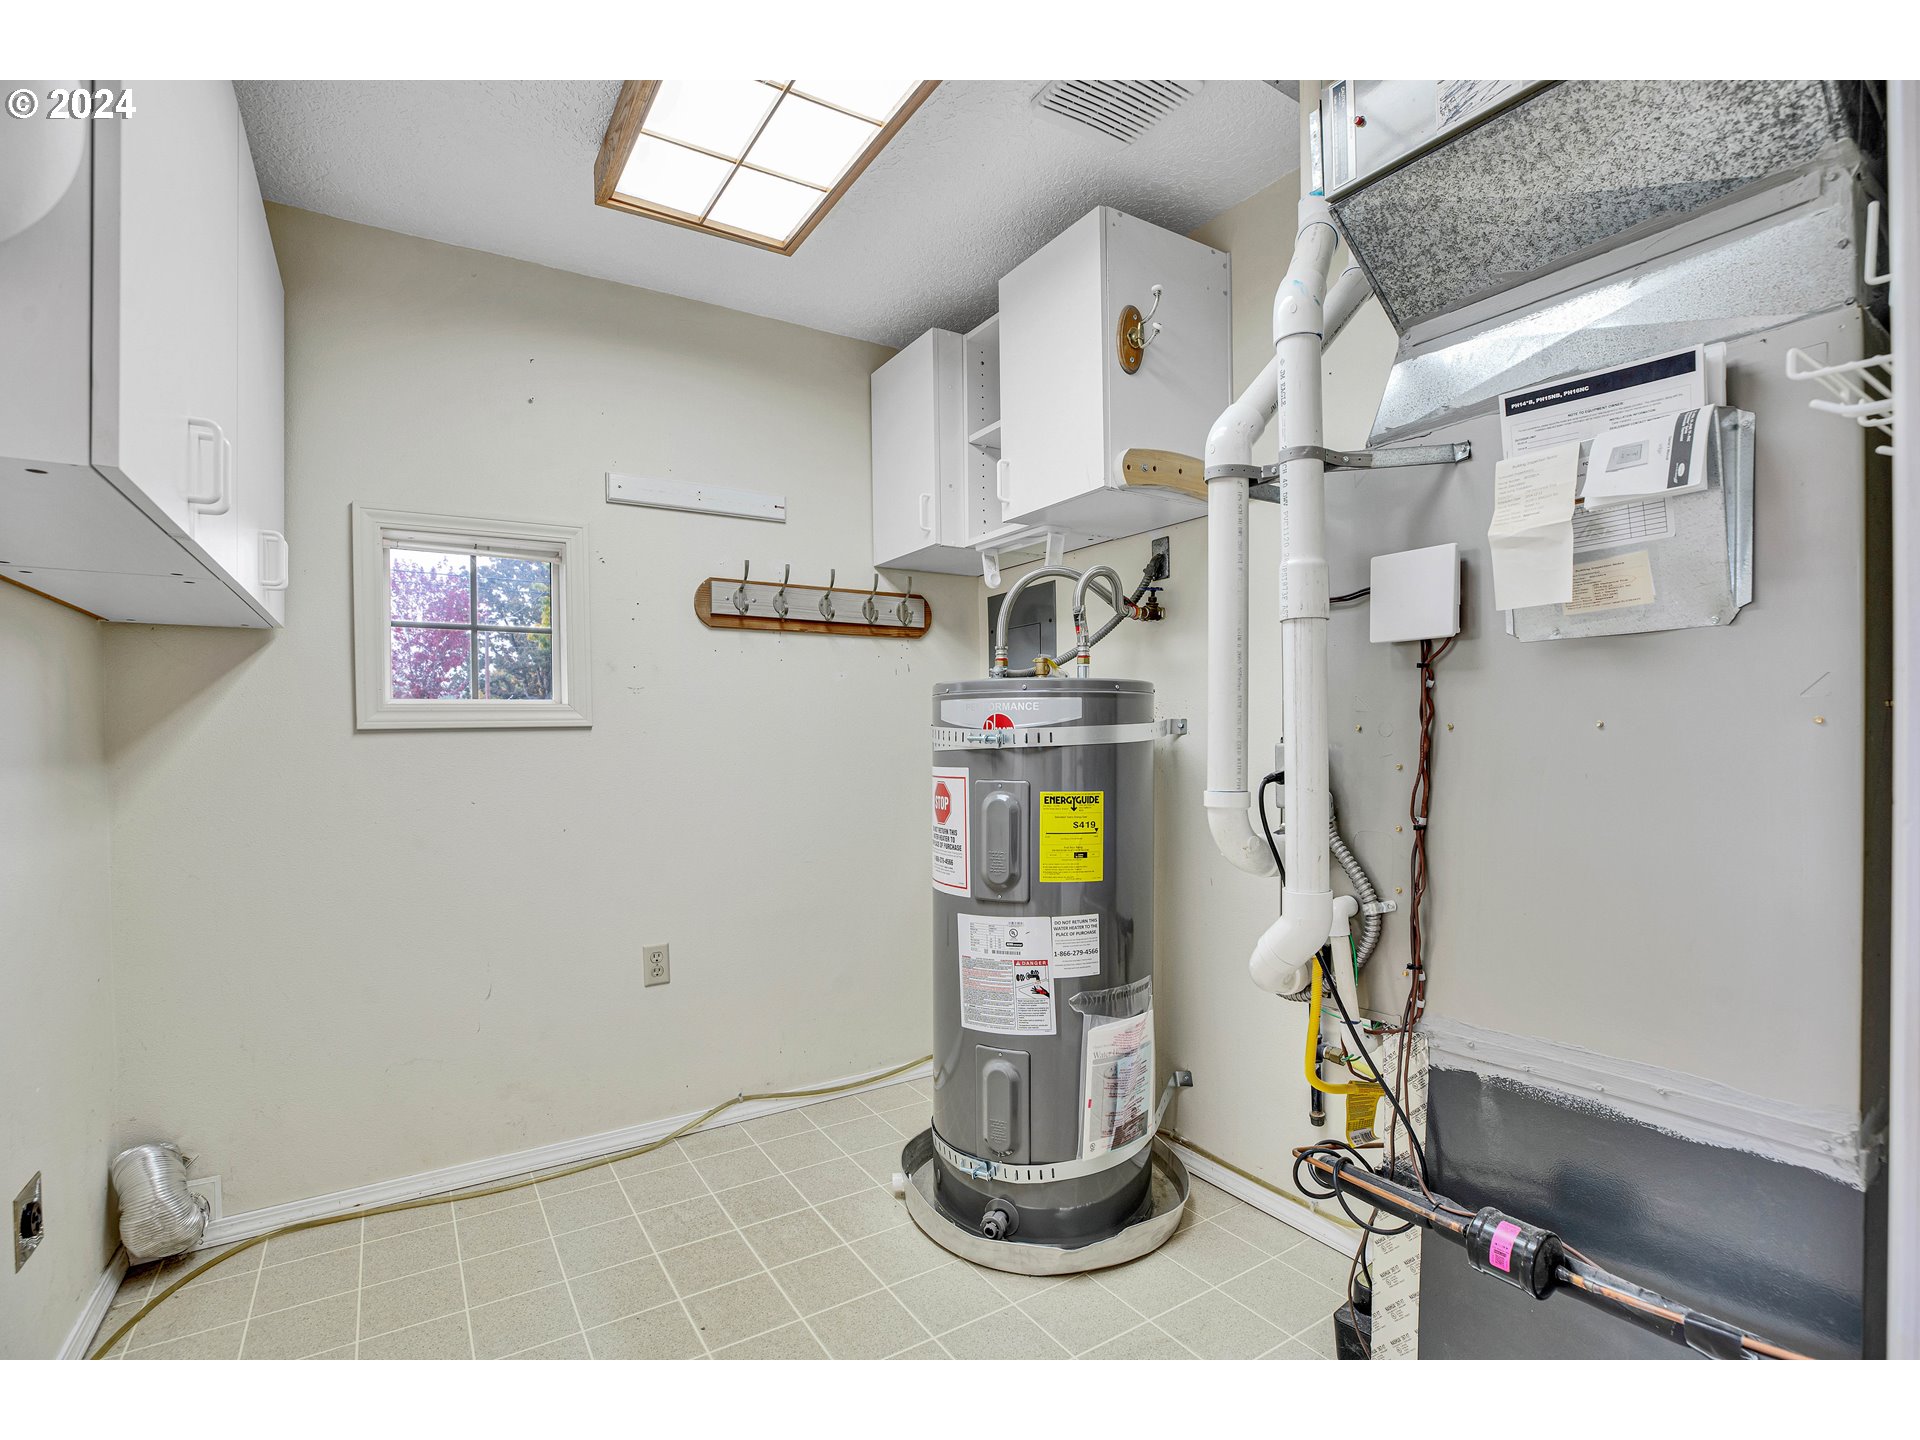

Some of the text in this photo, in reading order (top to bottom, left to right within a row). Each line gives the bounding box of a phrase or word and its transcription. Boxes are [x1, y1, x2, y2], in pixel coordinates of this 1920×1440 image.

[935, 795, 949, 810] STOP
[1044, 796, 1100, 804] ENERGYGUIDE
[944, 843, 962, 851] PURCHASE
[1054, 948, 1098, 957] 1-866-279-4566
